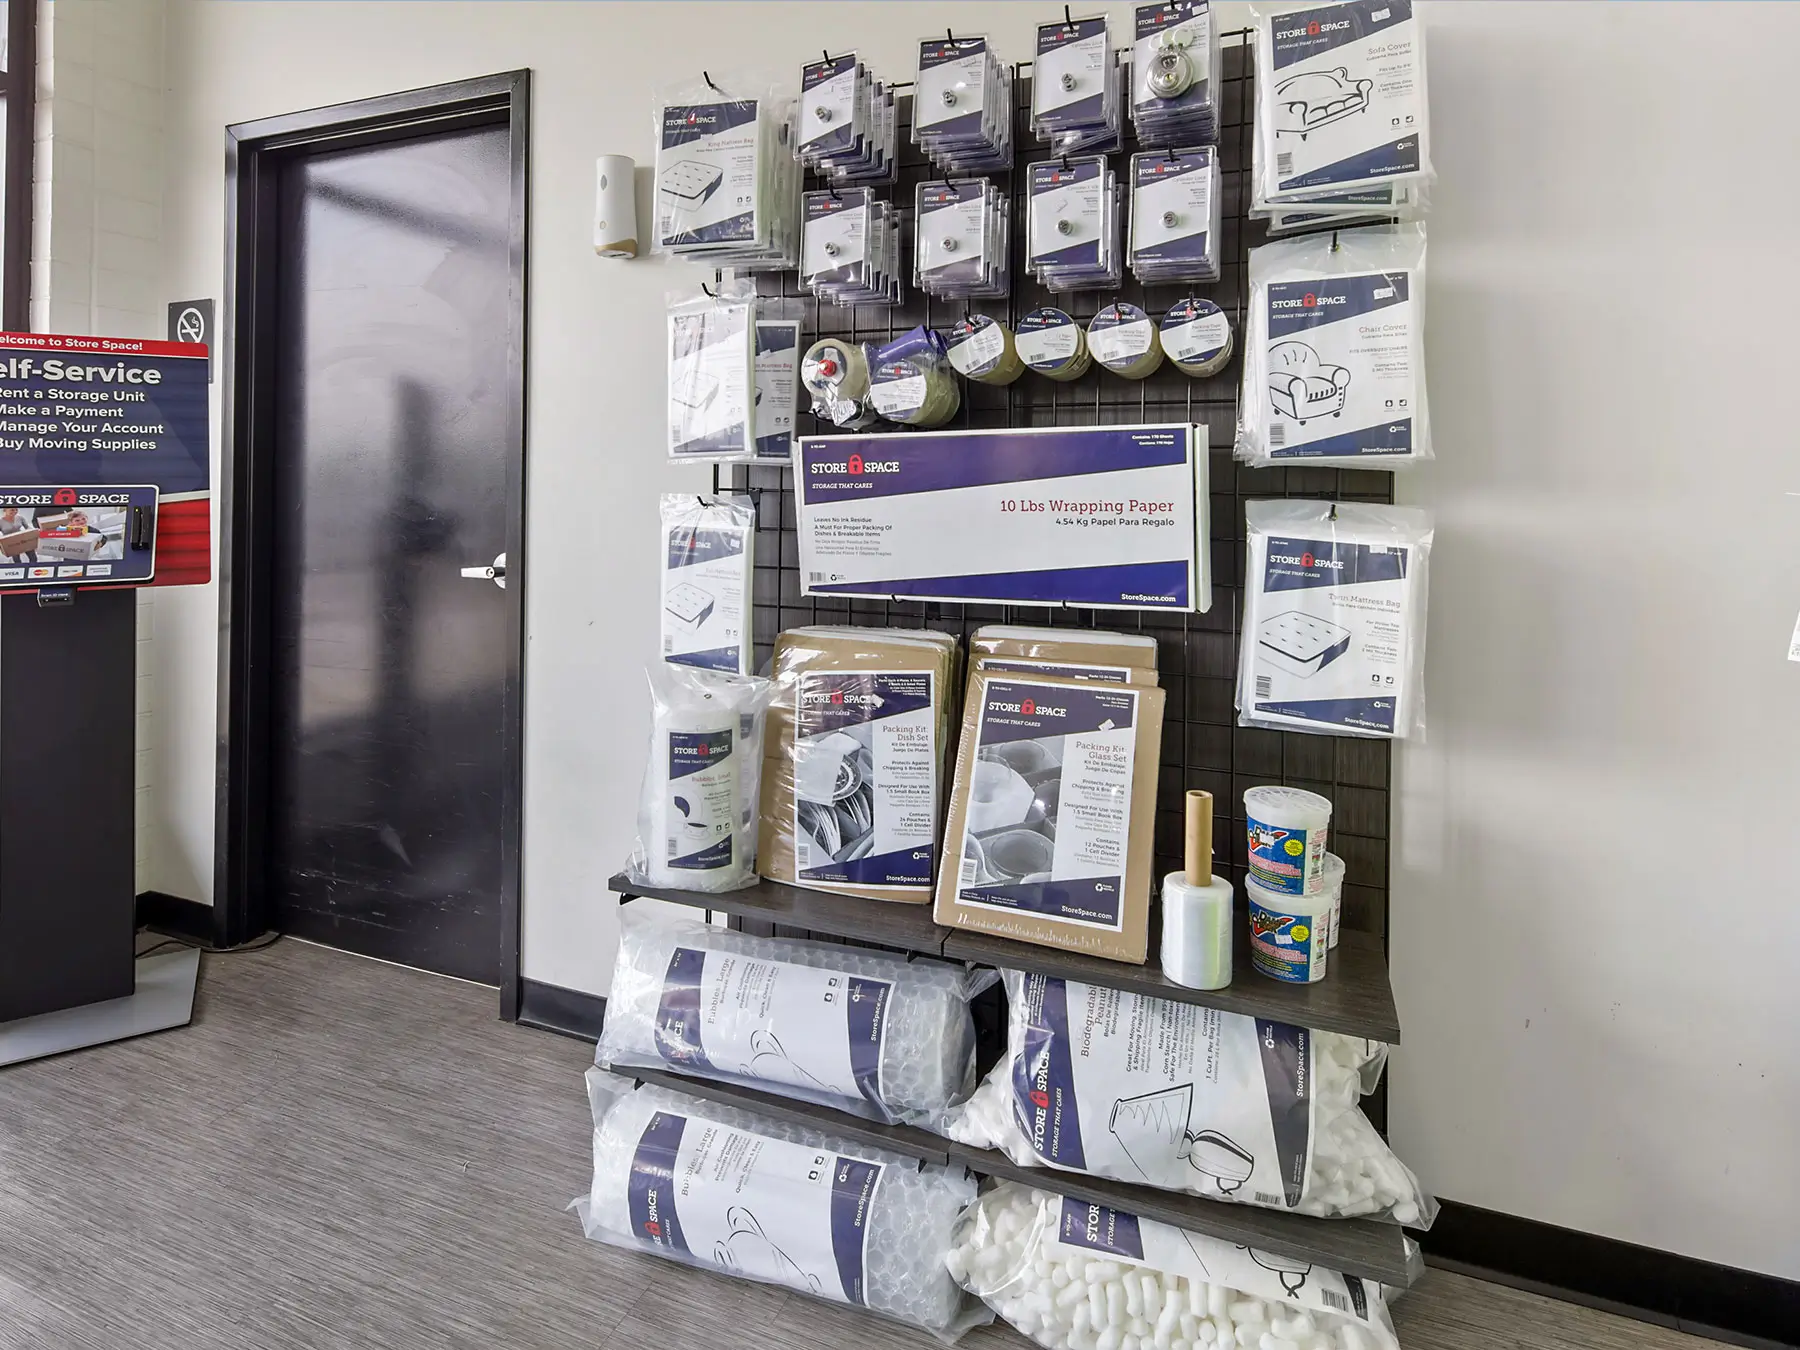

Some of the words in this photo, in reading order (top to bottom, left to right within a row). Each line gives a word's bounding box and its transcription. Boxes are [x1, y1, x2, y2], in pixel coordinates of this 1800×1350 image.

[1276, 28, 1307, 40] STORE
[1320, 21, 1350, 32] SPACE
[1368, 46, 1386, 55] Sofa
[1388, 42, 1411, 51] Cover
[665, 118, 688, 126] STORE
[696, 116, 717, 124] SPACE
[1370, 162, 1414, 174] StoreSpace.com
[1272, 298, 1302, 308] STORE
[1316, 296, 1346, 306] SPACE
[49, 338, 62, 346] to
[65, 338, 99, 348] Store
[102, 340, 143, 350] Space!
[0, 388, 29, 399] ent
[34, 390, 43, 399] a
[48, 388, 109, 403] Storage
[114, 390, 145, 402] Unit
[41, 407, 50, 415] a
[56, 405, 124, 418] Payment
[62, 422, 97, 432] Your
[102, 422, 164, 434] Account
[29, 438, 87, 451] Moving
[92, 438, 156, 451] Supplies
[811, 462, 848, 474] STORE
[864, 462, 900, 473] SPACE
[79, 494, 130, 503] SPACE
[1000, 500, 1016, 512] 10
[1021, 500, 1045, 512] Lbs
[1049, 500, 1124, 515] Wrapping
[1129, 500, 1174, 514] Paper
[1076, 518, 1088, 527] Kg
[1091, 518, 1116, 527] Papel
[1142, 518, 1174, 527] Regalo
[1270, 555, 1300, 565] STORE
[1314, 560, 1344, 570] SPACE
[1121, 593, 1176, 602] StoreSpace.com
[1350, 596, 1384, 605] Mattress
[1386, 600, 1400, 608] Bag
[802, 695, 830, 704] STORE
[988, 702, 1020, 713] STORE
[1036, 706, 1067, 717] SPACE
[1345, 717, 1390, 729] StoreSpace.com
[882, 726, 913, 734] Packing
[709, 744, 729, 754] SPACE
[1076, 741, 1110, 753] Packing
[1088, 751, 1112, 761] Glass
[1114, 753, 1127, 762] Set
[886, 875, 930, 883] StoreSpace.com
[1061, 905, 1113, 920] StoreSpace.com
[716, 958, 730, 982] Large
[871, 987, 885, 1041] StoreSpace.com
[1137, 1011, 1145, 1032] Fragile
[1134, 1034, 1143, 1064] Shipping
[1037, 1050, 1050, 1092] SPACE
[1296, 1032, 1305, 1097] StoreSpace.com
[1034, 1108, 1048, 1151] STORE
[696, 1127, 712, 1152] Large
[1052, 1127, 1060, 1158] STORAGE
[715, 1156, 729, 1181] Prevents
[725, 1134, 738, 1155] Damage
[854, 1169, 874, 1228] StoreSpace.com
[648, 1189, 658, 1222] SPACE
[1087, 1204, 1099, 1242] STOR
